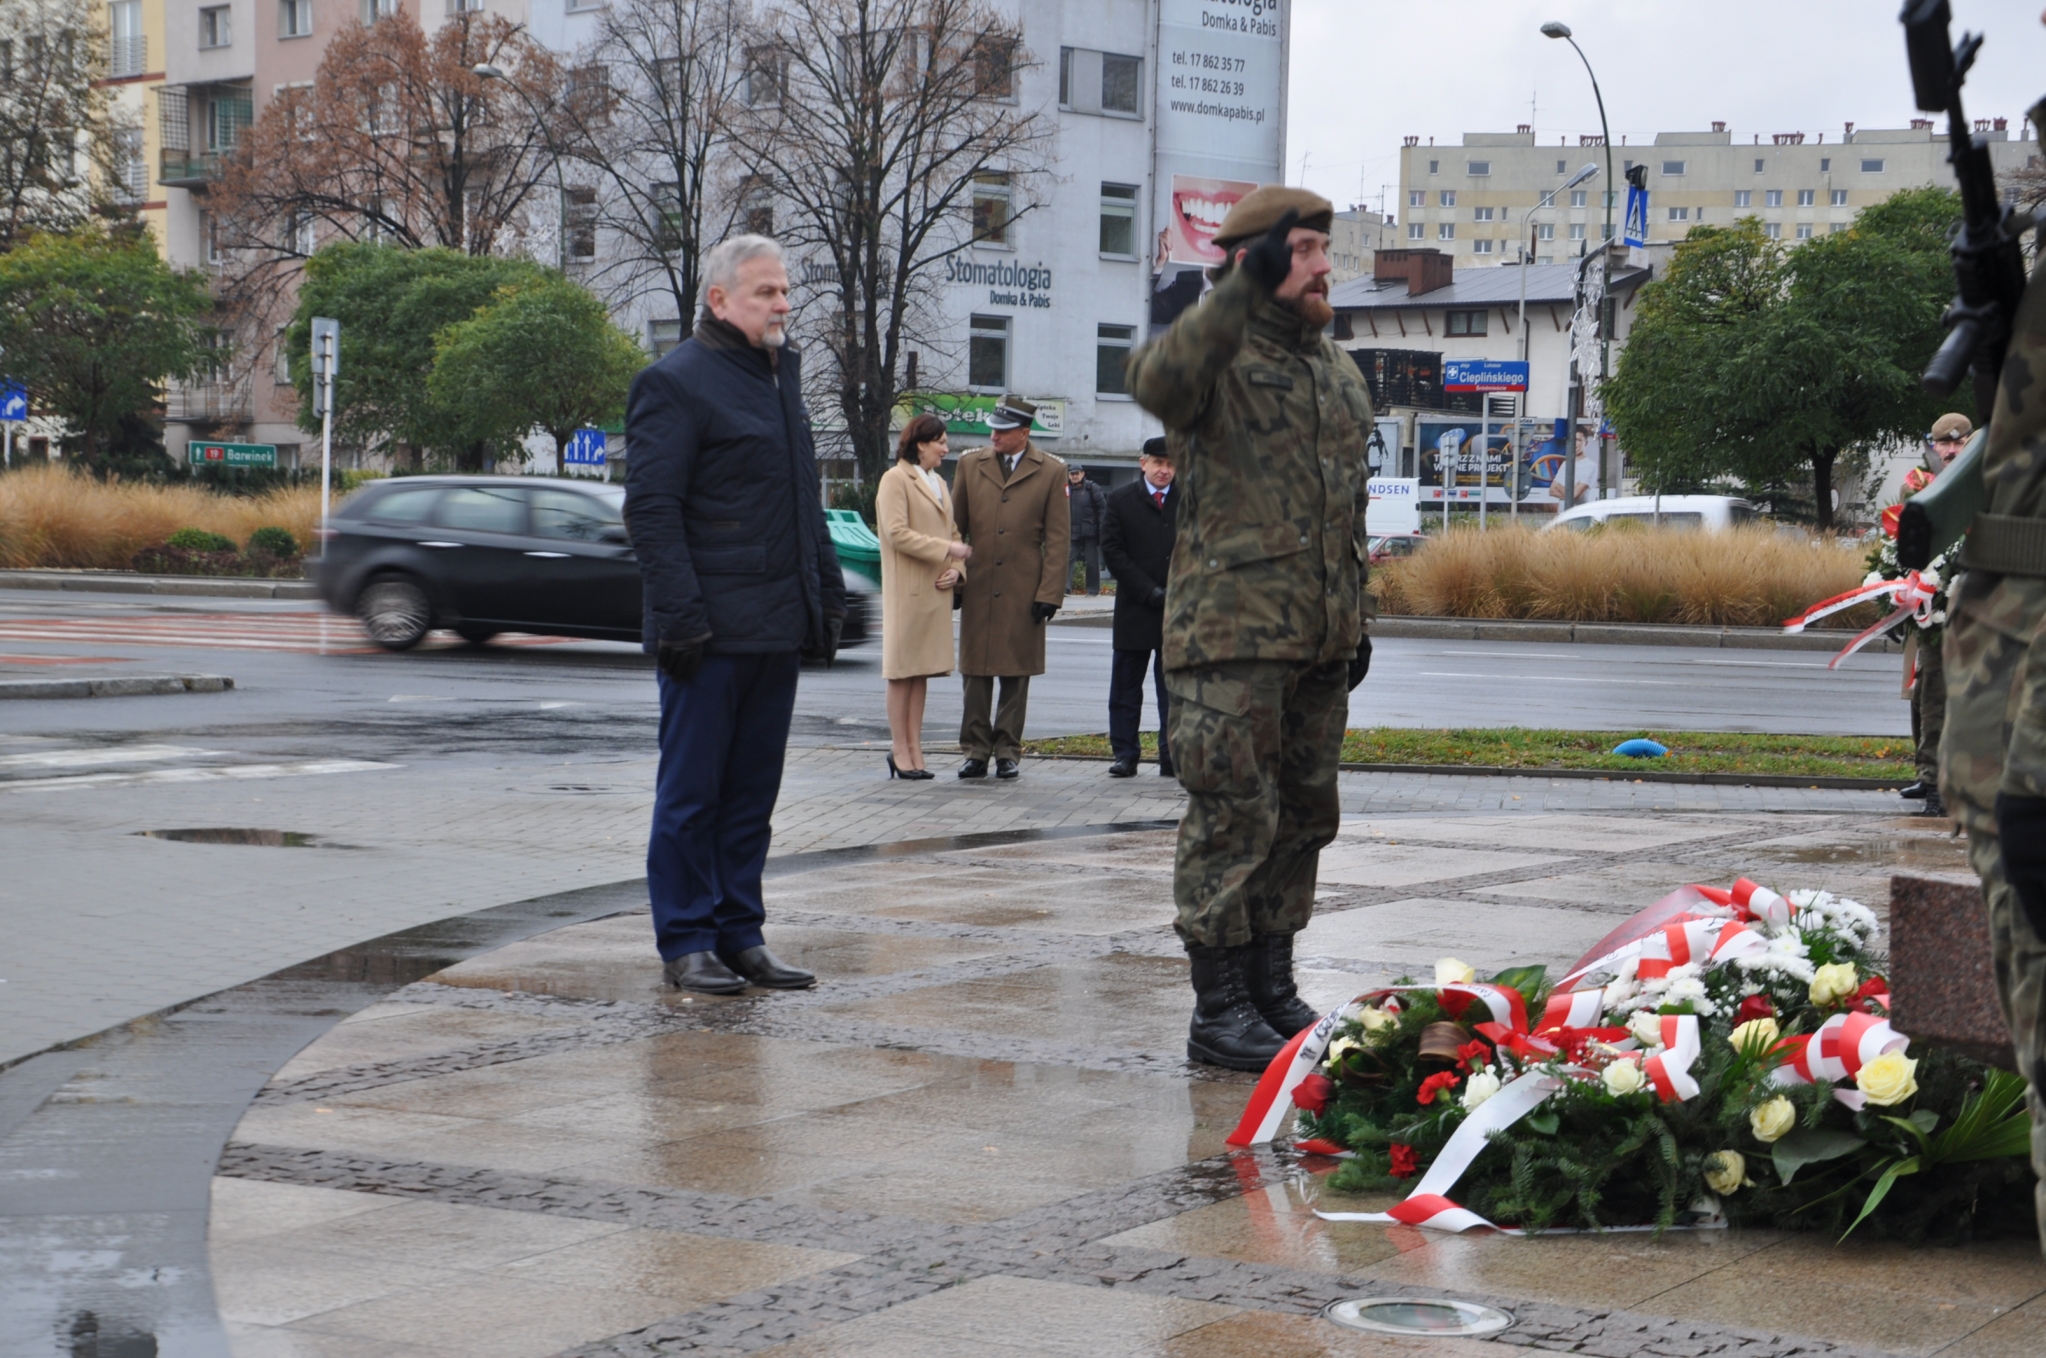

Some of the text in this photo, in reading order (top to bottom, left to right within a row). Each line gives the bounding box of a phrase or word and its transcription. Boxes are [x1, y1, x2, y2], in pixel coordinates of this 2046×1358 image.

[1202, 11, 1277, 37] Domka & Pabis
[1172, 51, 1245, 72] tel. 17 862 35 77
[1171, 74, 1244, 96] tel. 17 862 26 39
[1171, 99, 1265, 124] www.domkapabis.pl
[945, 254, 1051, 290] Stomatologia
[990, 290, 1051, 308] Domka & Pabis
[1460, 372, 1524, 385] Cieplińskiego
[210, 449, 273, 461] 19 Barwinek
